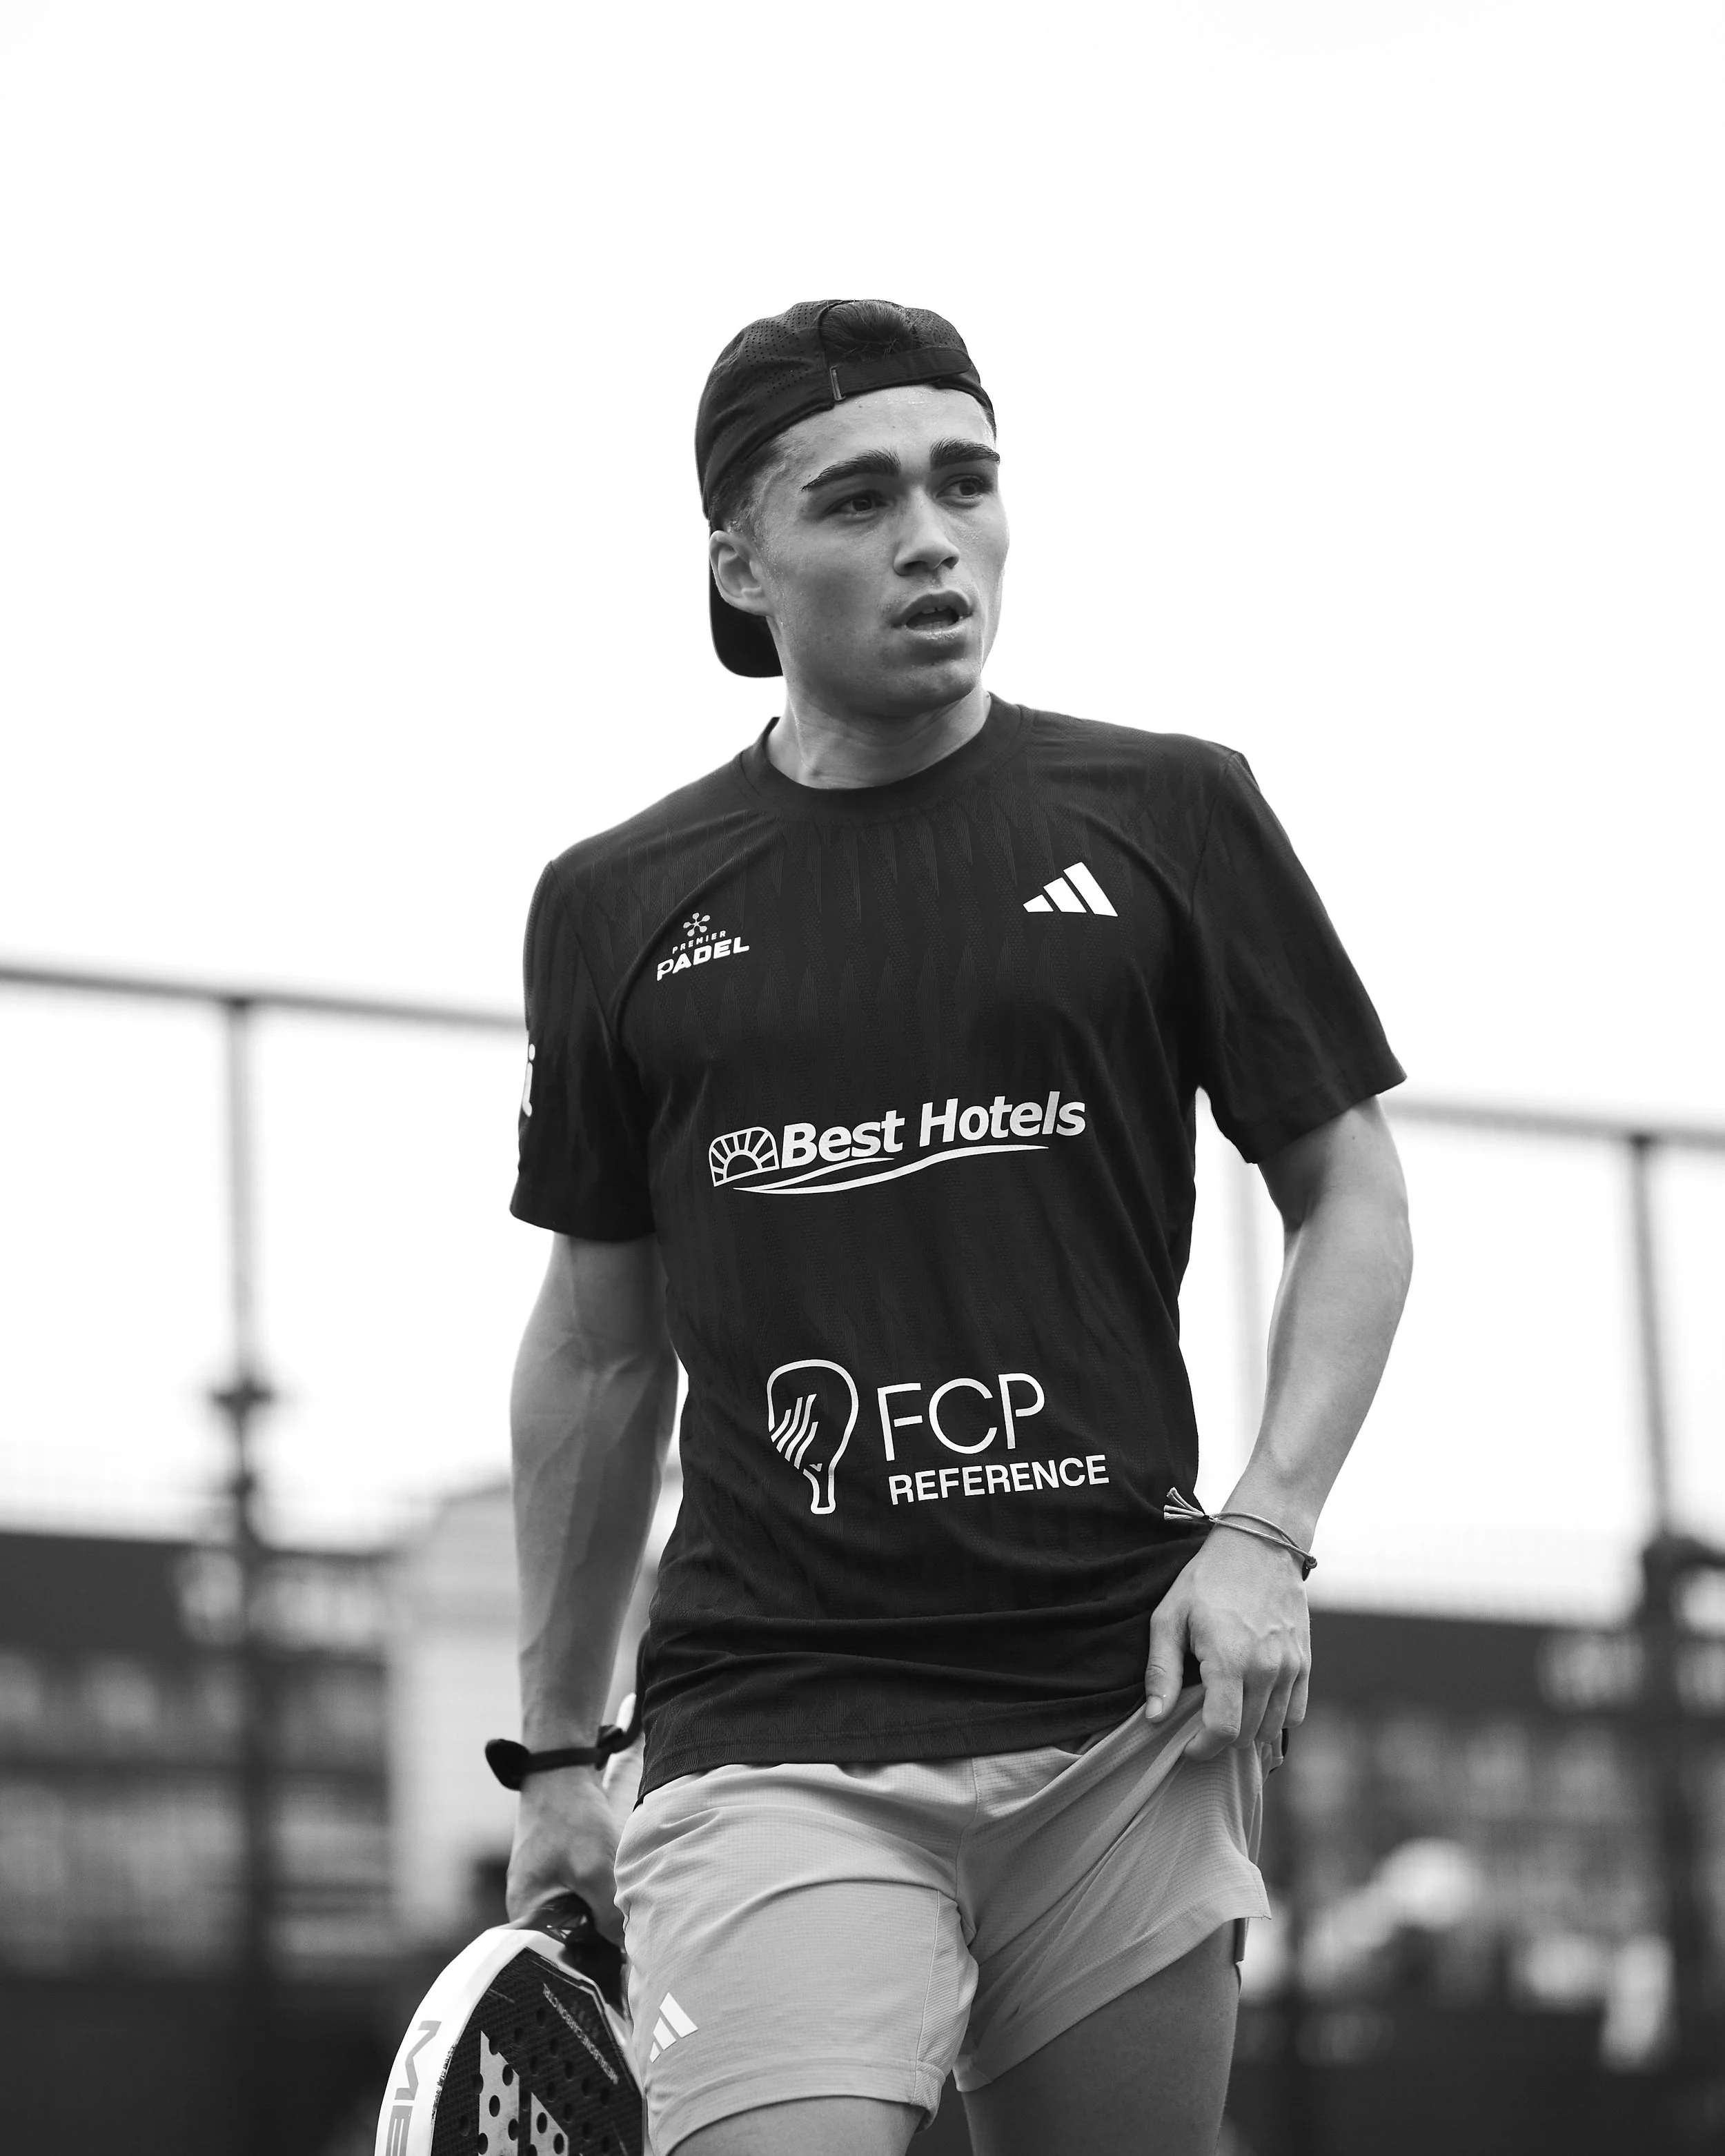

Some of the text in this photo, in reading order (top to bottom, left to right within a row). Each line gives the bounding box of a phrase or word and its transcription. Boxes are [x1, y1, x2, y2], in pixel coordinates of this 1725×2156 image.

[656, 936, 750, 981] PADEL
[672, 931, 726, 954] PREMIER
[781, 1091, 1086, 1169] Best Hotels
[877, 1372, 1045, 1461] FCP
[888, 1454, 1110, 1505] REFERENCE
